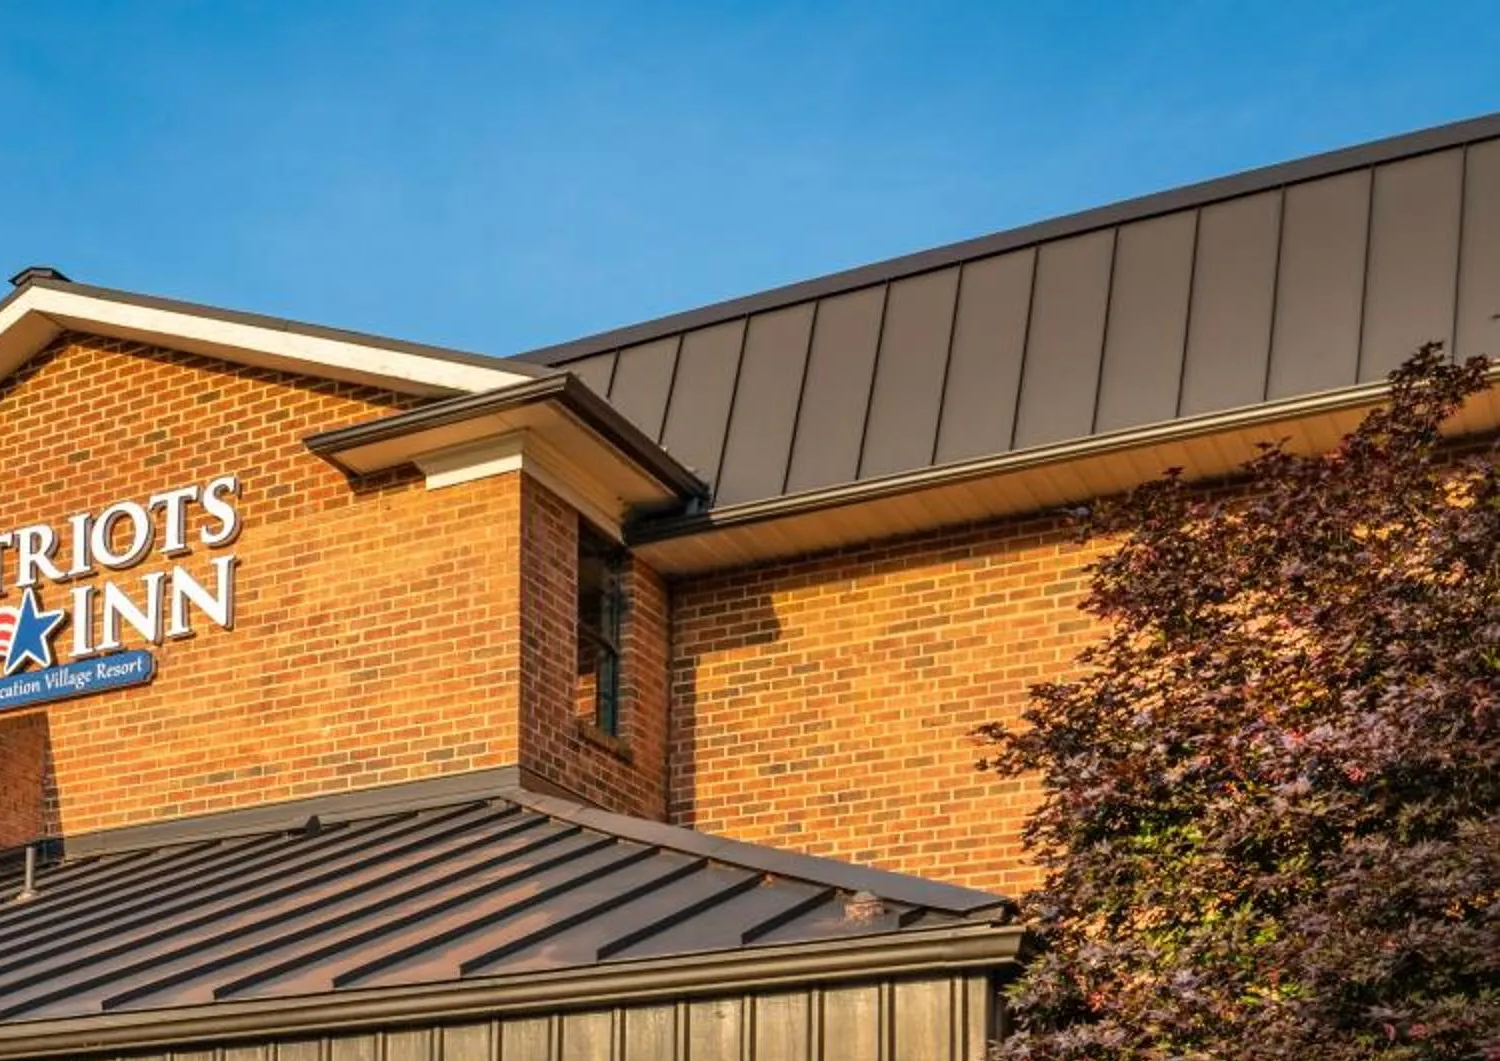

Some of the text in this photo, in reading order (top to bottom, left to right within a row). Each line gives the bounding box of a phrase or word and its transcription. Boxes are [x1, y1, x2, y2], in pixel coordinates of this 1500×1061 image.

[68, 555, 236, 658] INN
[45, 668, 93, 690] Village
[97, 656, 143, 679] Resort
